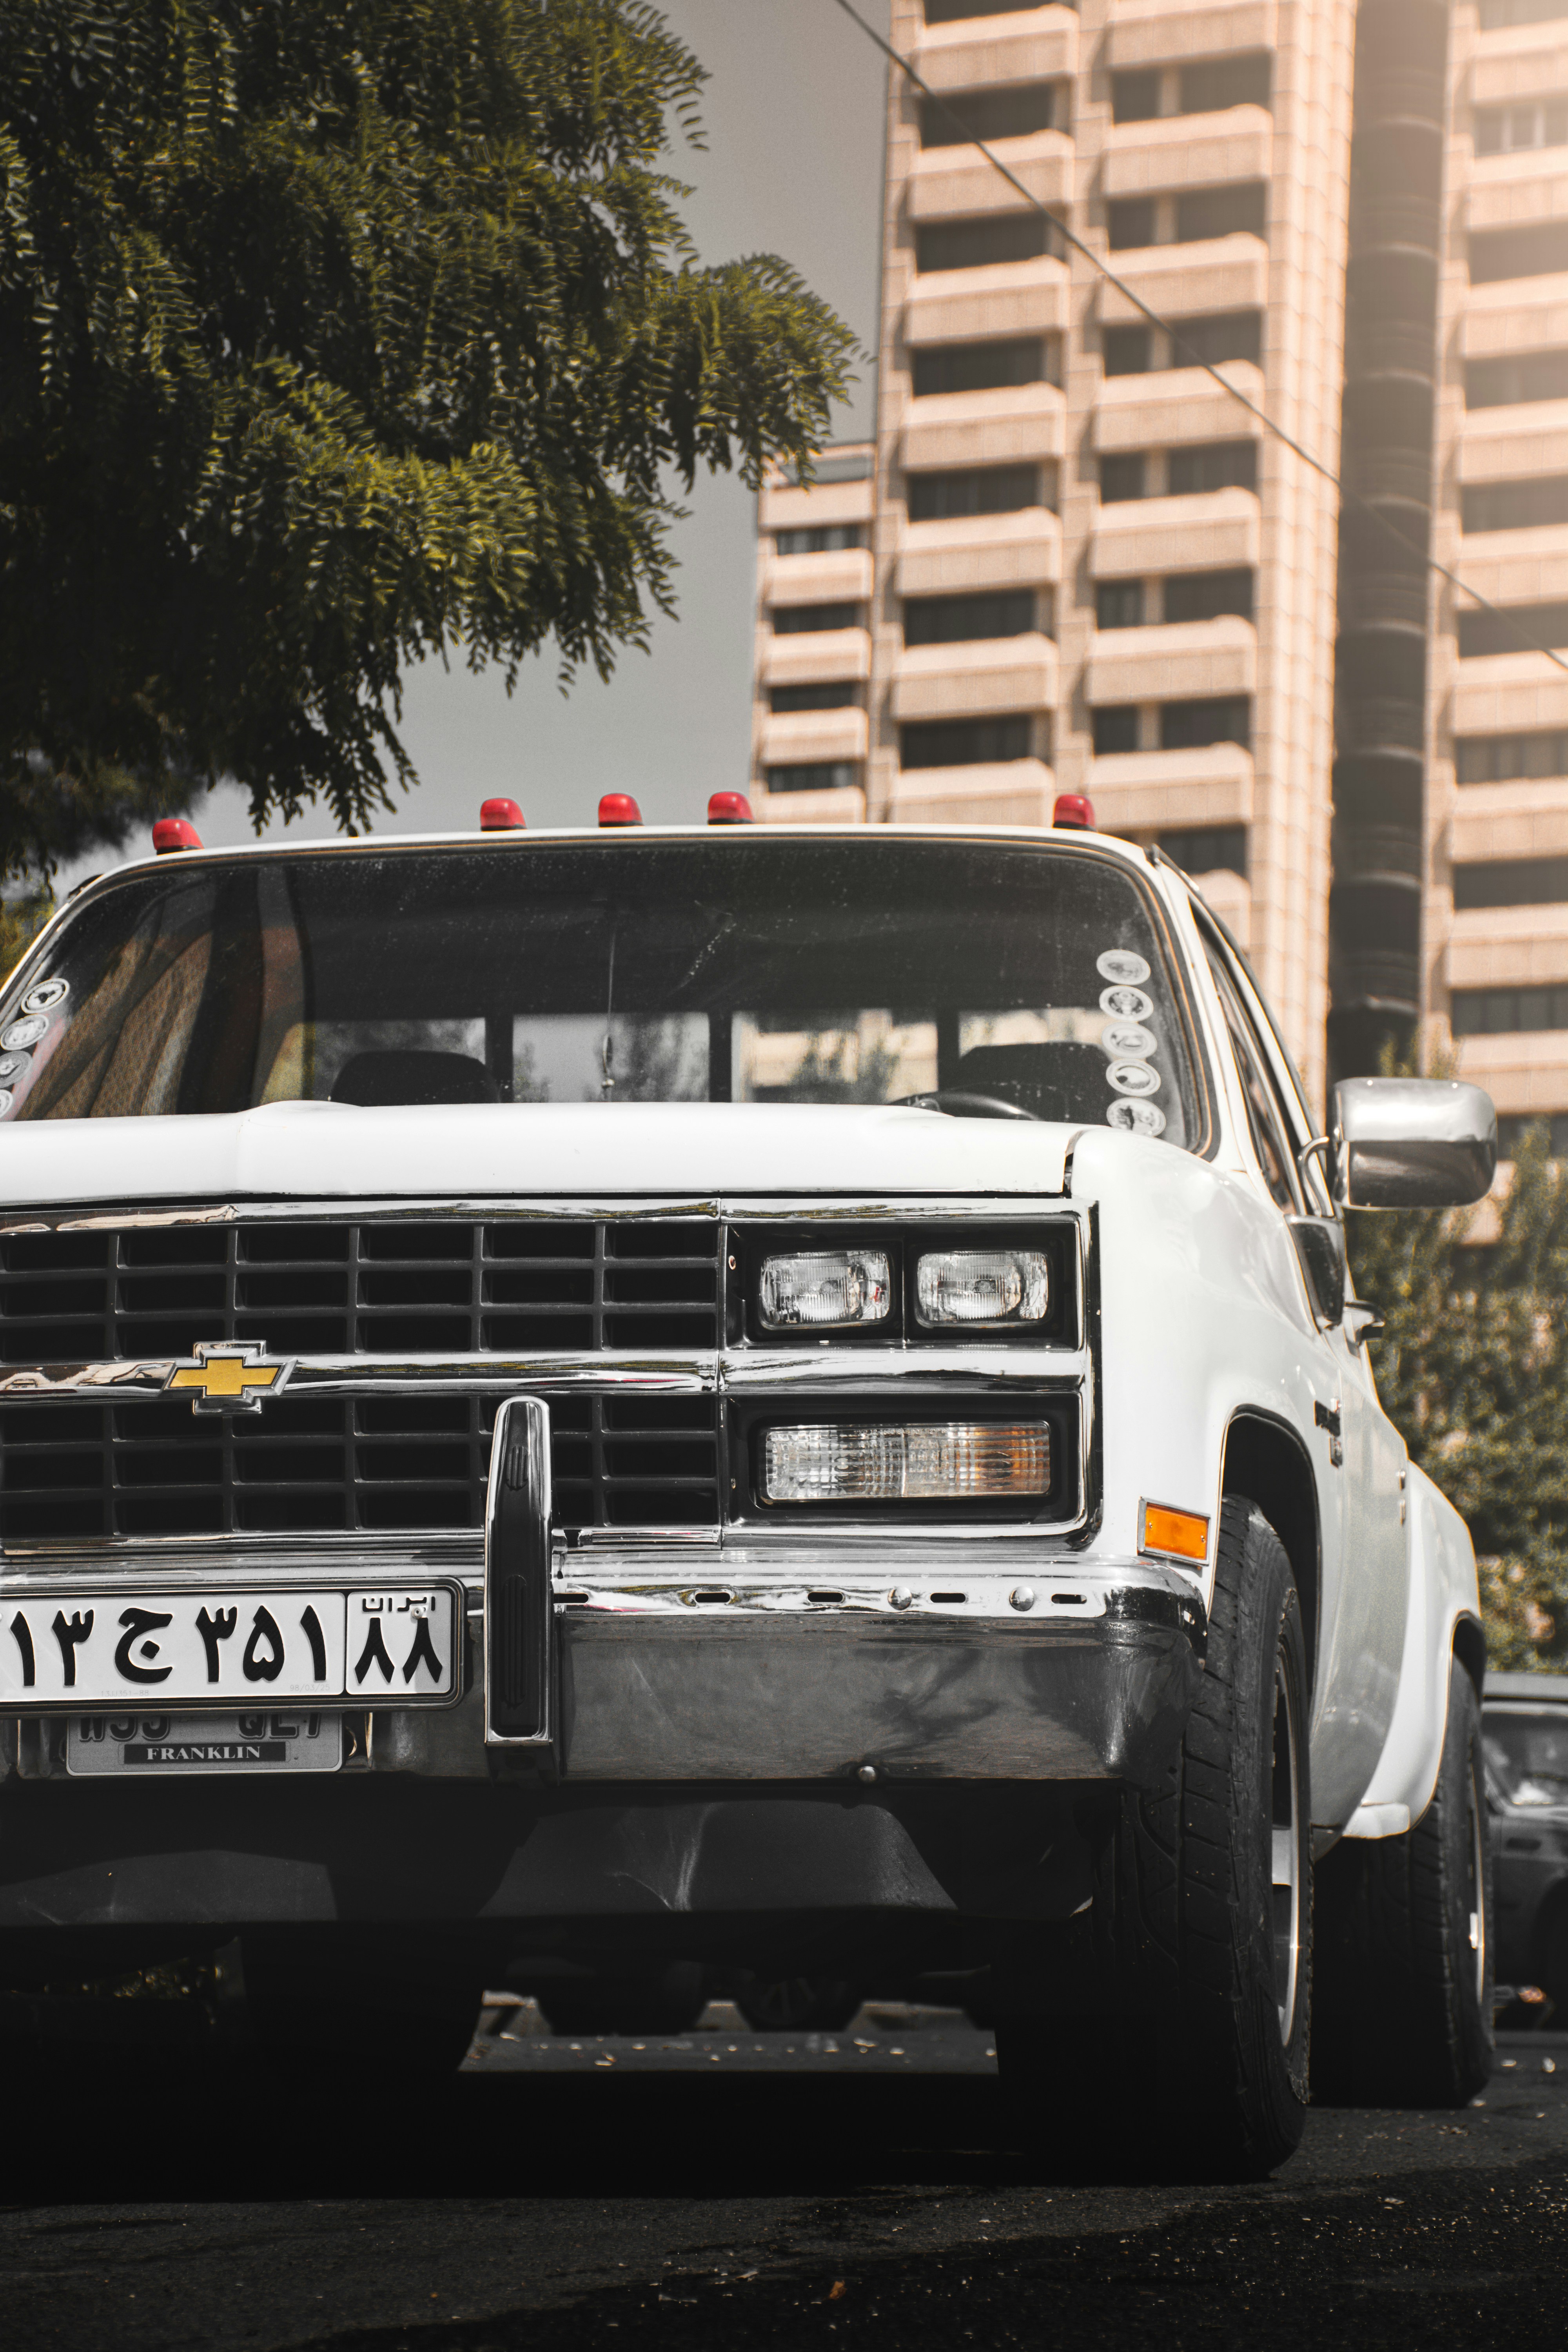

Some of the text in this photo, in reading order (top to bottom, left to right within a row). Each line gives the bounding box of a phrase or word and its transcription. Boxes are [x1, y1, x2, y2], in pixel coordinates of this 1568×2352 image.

[363, 1596, 436, 1612] ایران
[196, 1604, 326, 1682] ۳۵۱
[354, 1617, 443, 1684] ۸۸
[290, 1684, 330, 1692] 98/03/25
[146, 1746, 261, 1760] FRANKLIN
